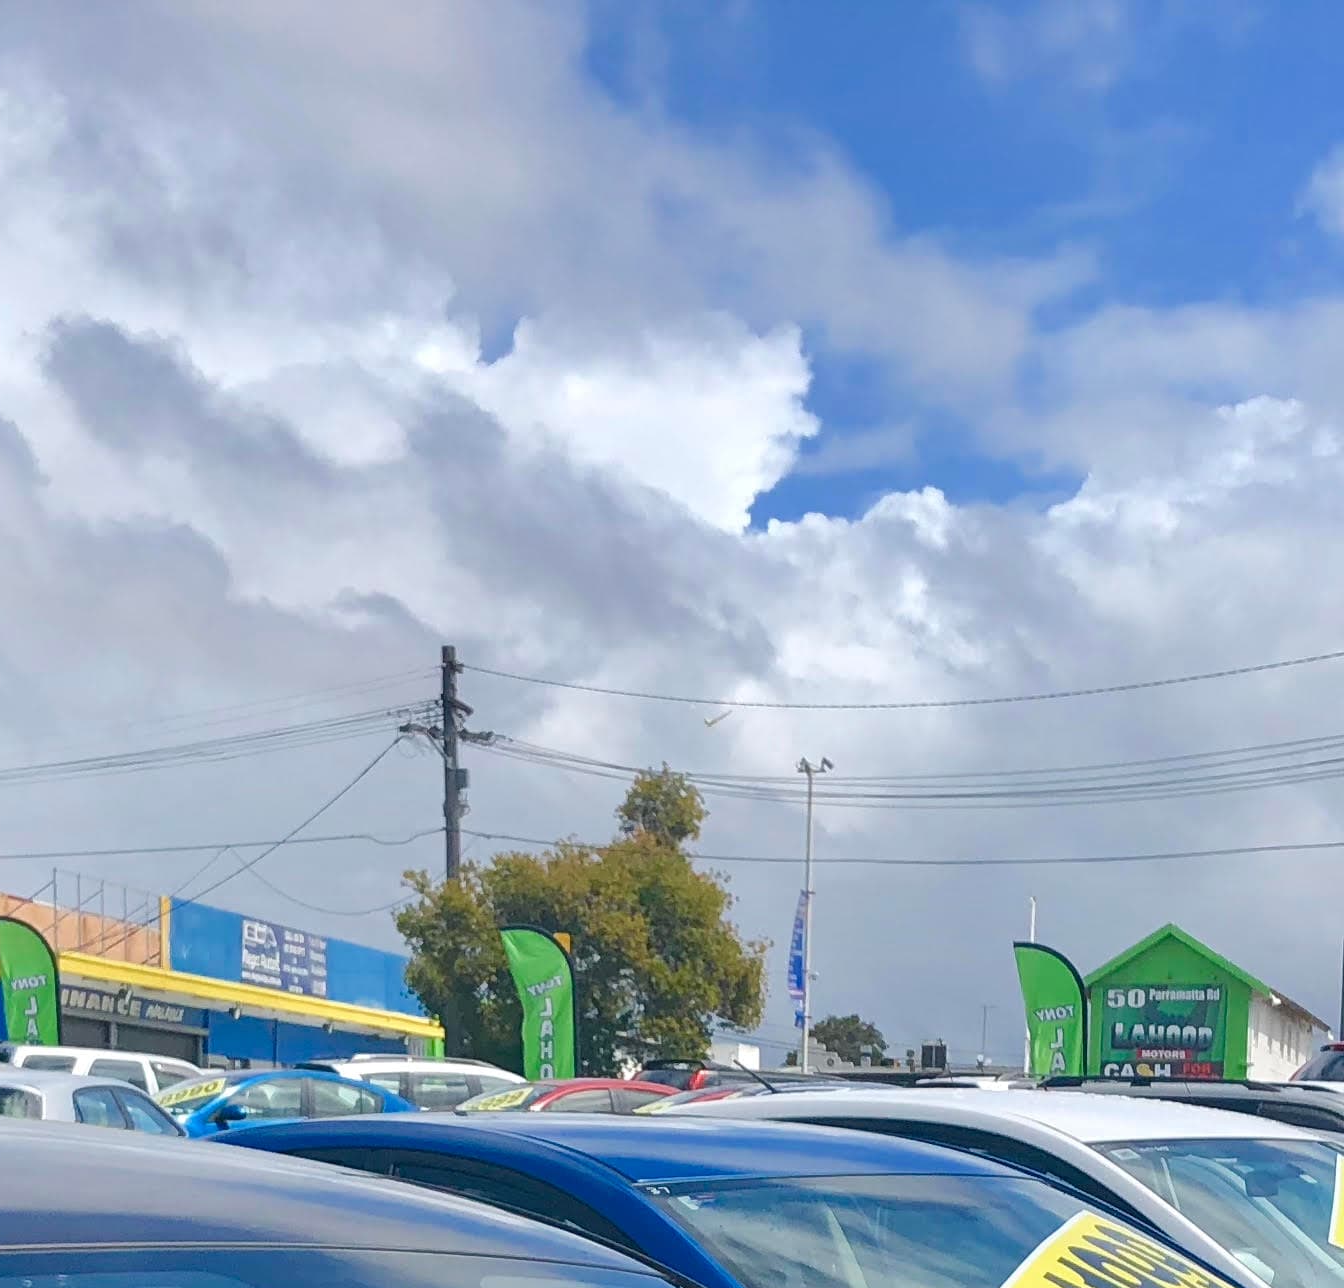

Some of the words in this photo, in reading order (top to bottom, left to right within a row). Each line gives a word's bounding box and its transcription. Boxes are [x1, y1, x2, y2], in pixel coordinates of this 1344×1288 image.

[1107, 988, 1146, 1009] 50
[1149, 988, 1205, 1001] Parramatta
[1206, 988, 1220, 1001] Rd
[1112, 1022, 1213, 1049] LAHOOD
[1141, 1049, 1186, 1059] MOTORS
